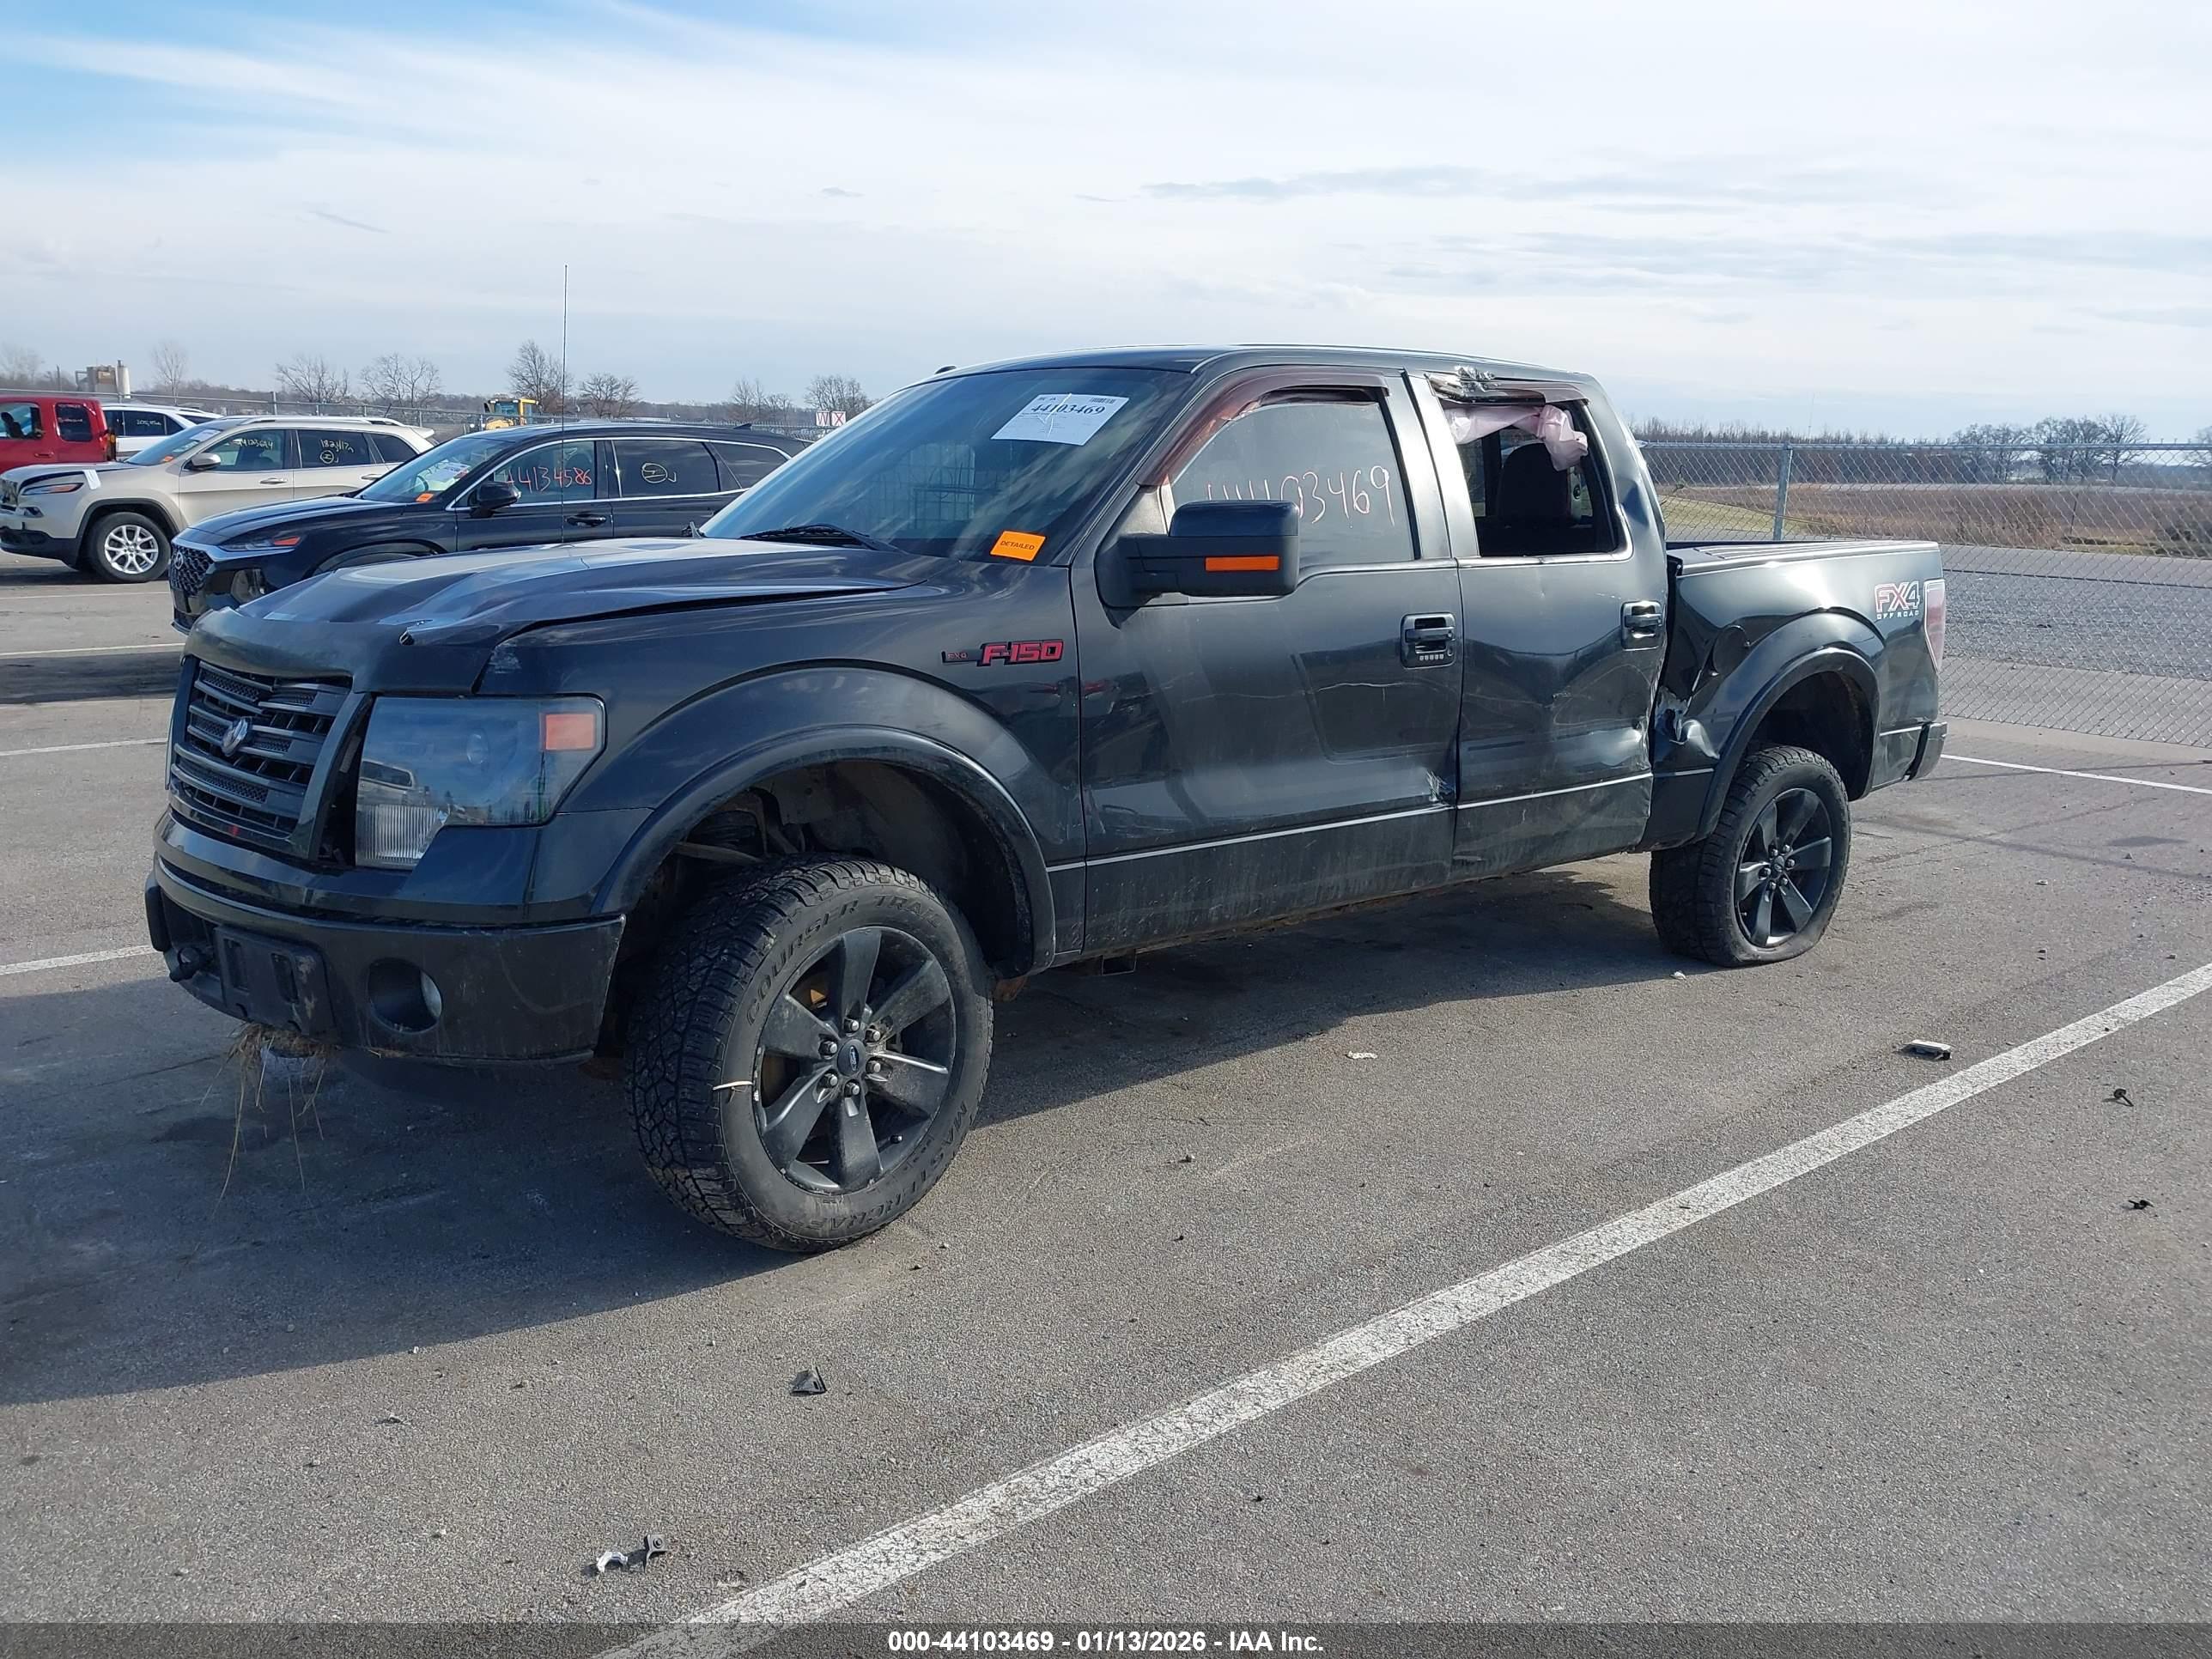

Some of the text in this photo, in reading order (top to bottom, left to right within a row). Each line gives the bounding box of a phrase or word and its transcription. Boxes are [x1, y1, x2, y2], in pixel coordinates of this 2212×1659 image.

[817, 412, 830, 425] W
[1030, 404, 1106, 415] 44103469
[1000, 541, 1036, 550] DETAILED
[1875, 581, 1920, 612] FX4
[981, 641, 1064, 665] F-150
[746, 900, 858, 1025] COURSER
